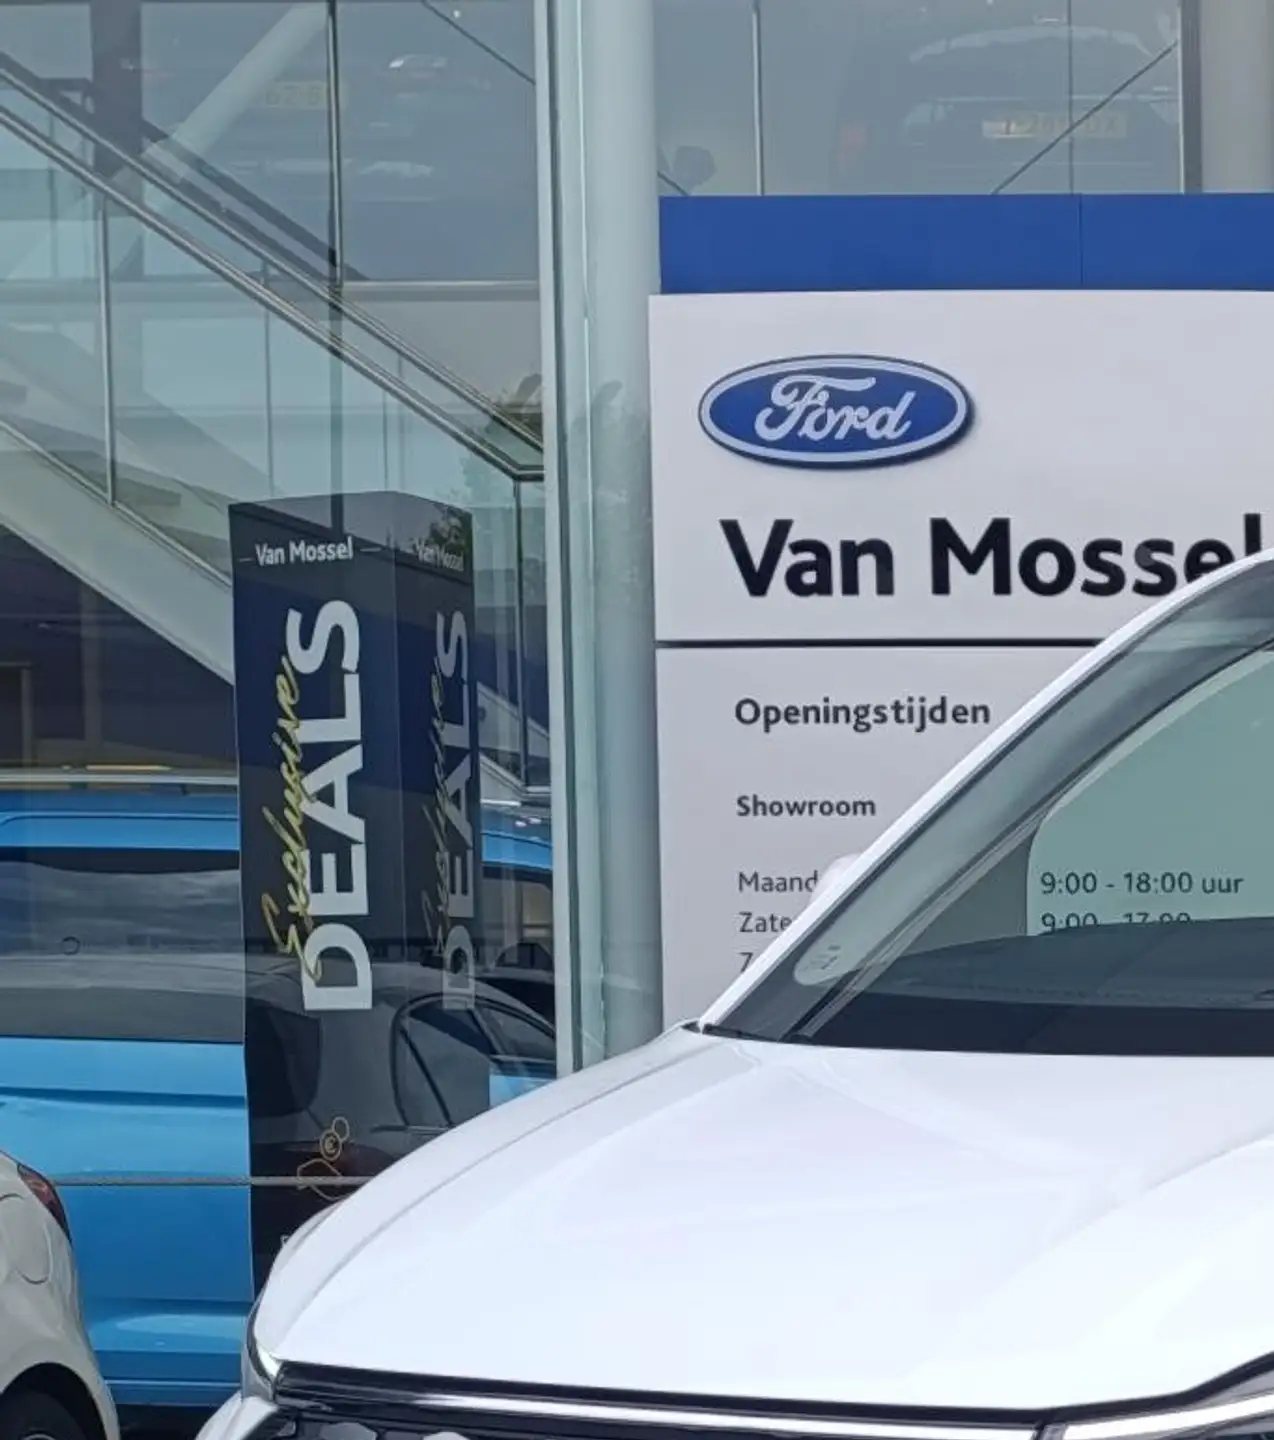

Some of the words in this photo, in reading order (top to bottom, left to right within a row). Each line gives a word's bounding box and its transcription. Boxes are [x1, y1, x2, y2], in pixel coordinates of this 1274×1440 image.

[754, 374, 916, 441] Ford
[256, 543, 286, 567] Van
[289, 535, 354, 563] Mossel
[719, 518, 895, 597] Van
[735, 696, 991, 734] Openingstijden
[261, 655, 323, 984] Exclusive
[286, 600, 373, 1010] DEALS
[435, 610, 476, 1010] DEALS
[737, 794, 877, 817] Showroom
[738, 869, 819, 893] Maand
[1040, 871, 1098, 895] 9:00
[1123, 871, 1193, 894] 18:00
[1201, 877, 1244, 894] uur
[738, 911, 793, 934] Zate
